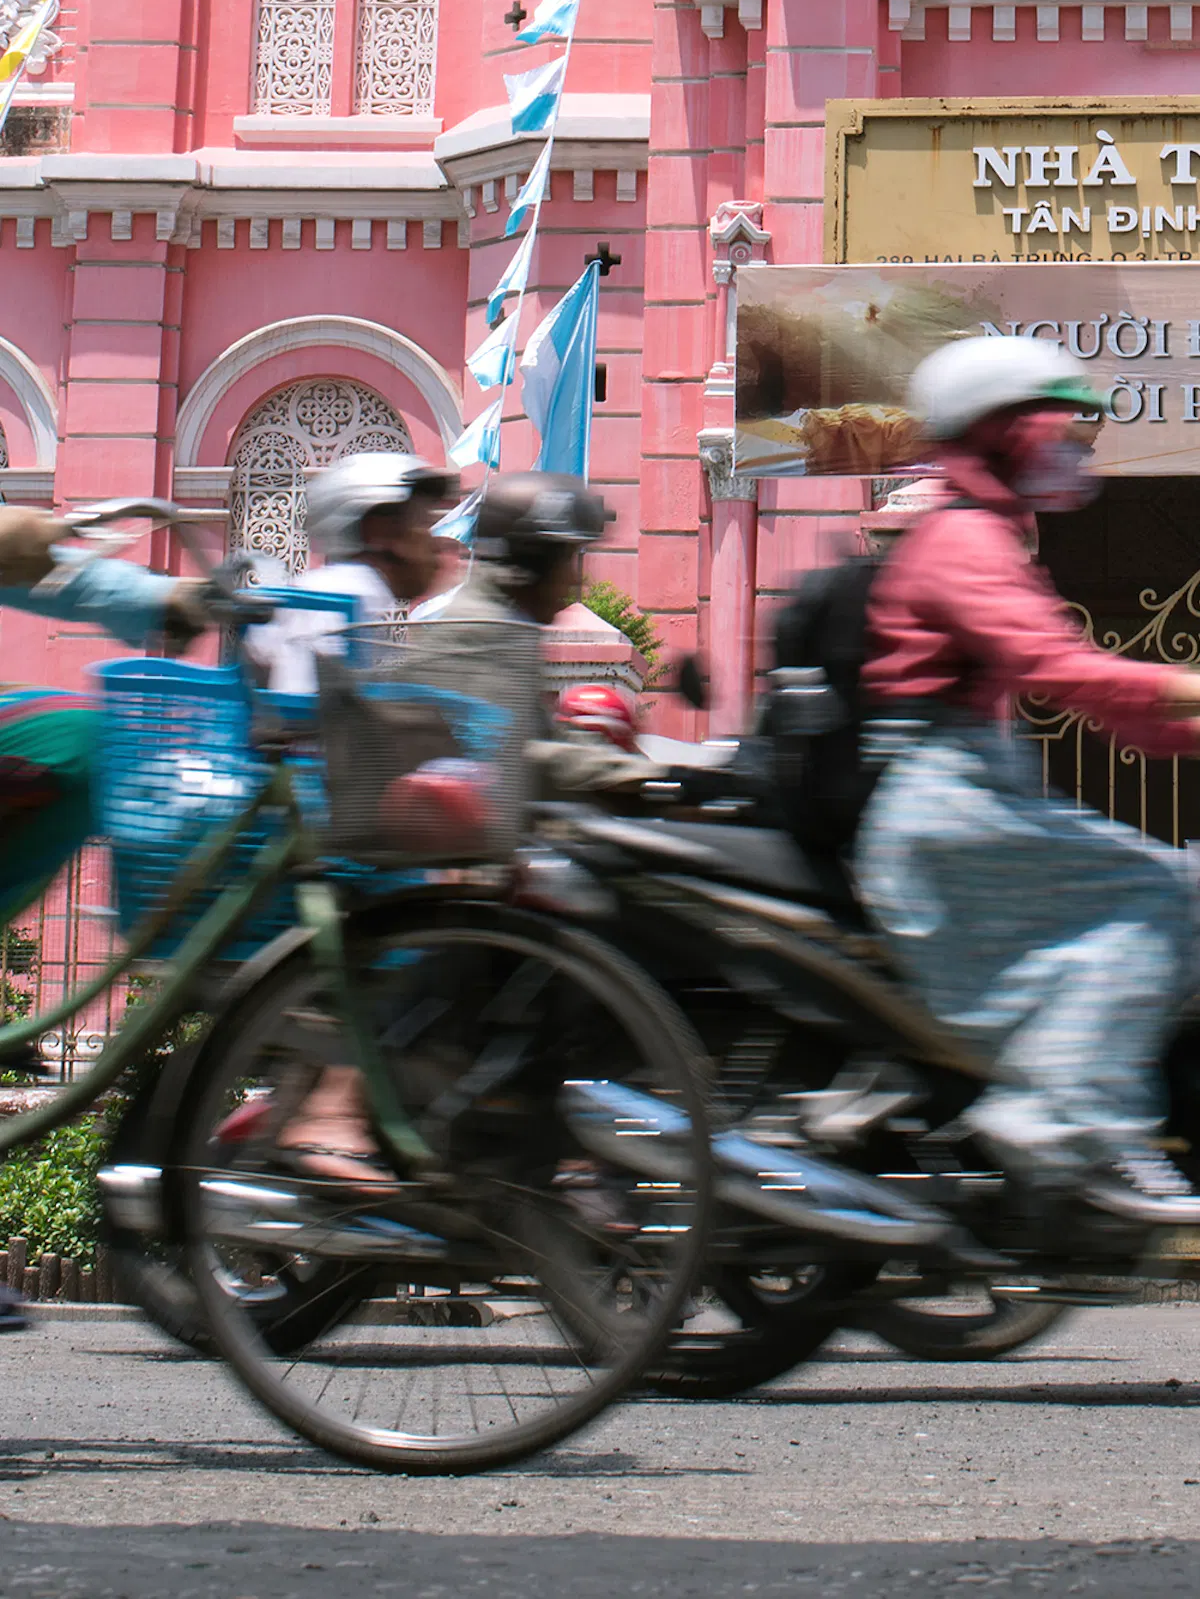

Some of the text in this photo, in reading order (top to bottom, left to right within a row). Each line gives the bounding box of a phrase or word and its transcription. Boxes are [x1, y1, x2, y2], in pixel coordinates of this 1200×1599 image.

[973, 130, 1136, 188] NHÀ
[1003, 200, 1091, 234] TÂN
[1072, 375, 1166, 422] ỜI
